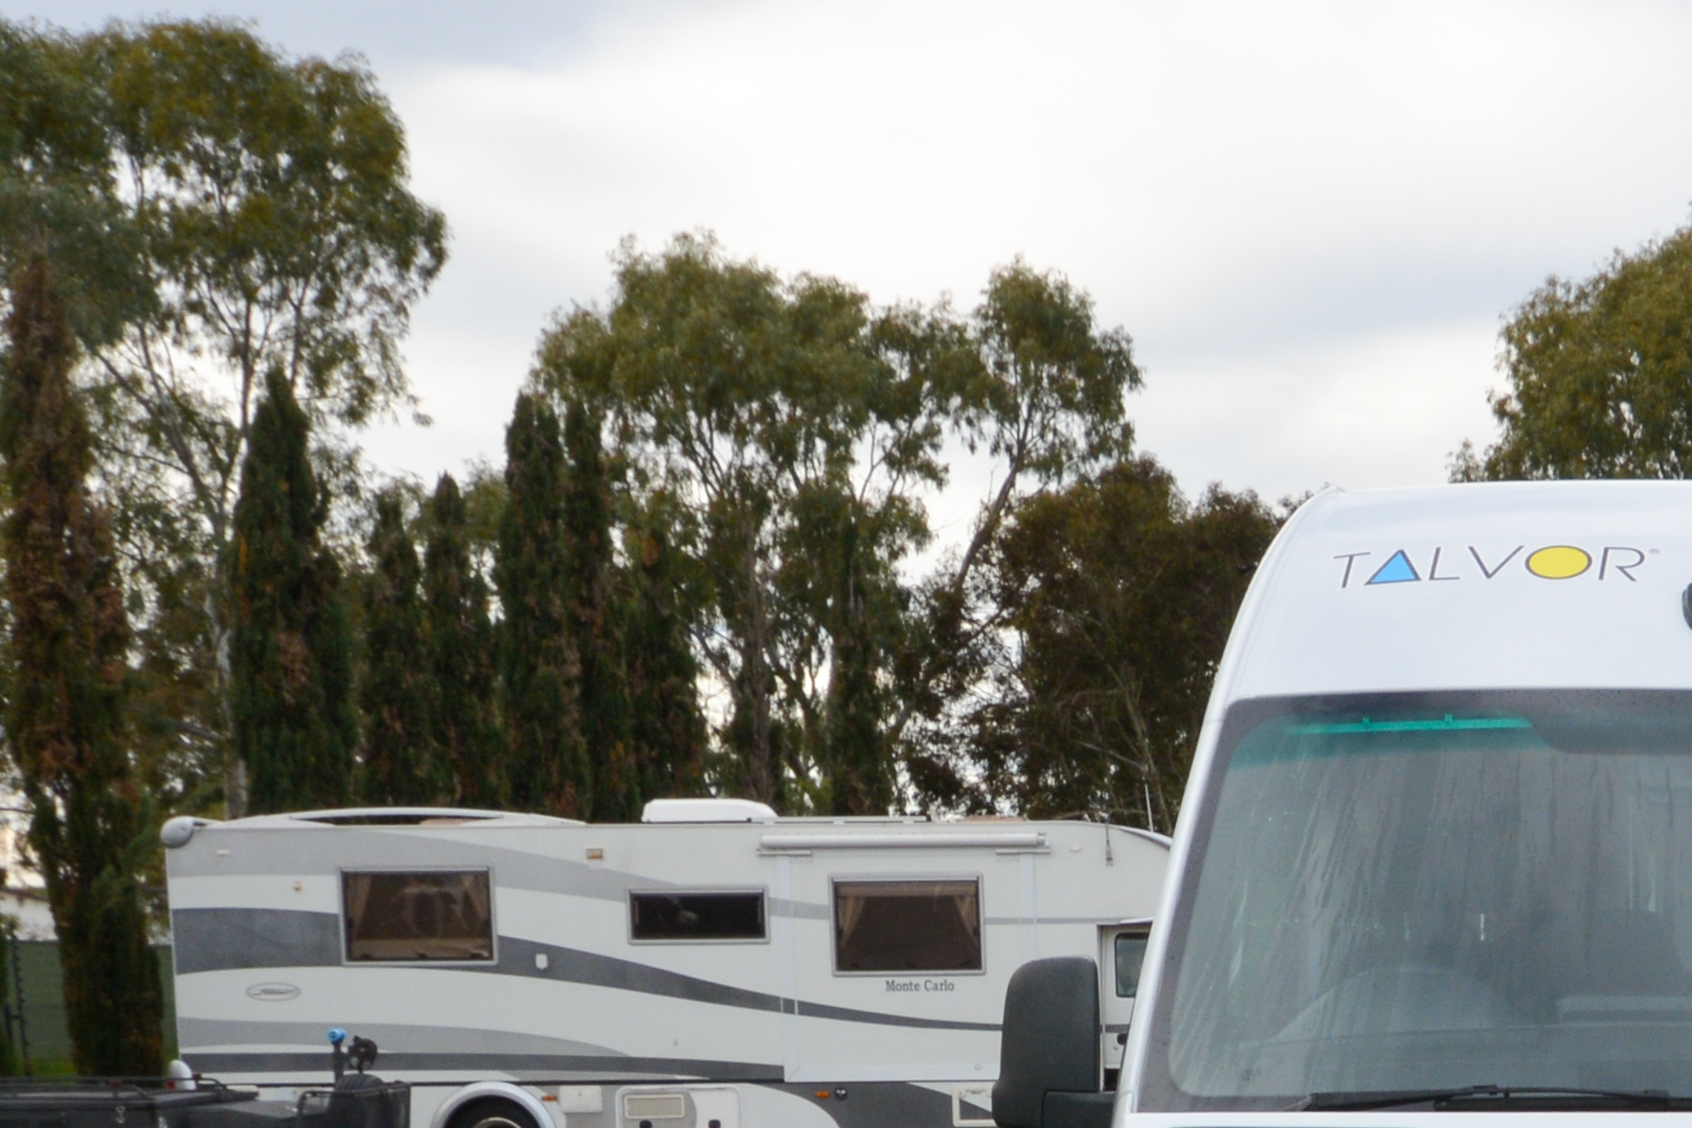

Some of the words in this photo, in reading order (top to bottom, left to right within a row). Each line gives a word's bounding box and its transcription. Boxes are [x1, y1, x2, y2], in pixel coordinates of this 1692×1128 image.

[1333, 544, 1646, 589] TALVOR
[885, 980, 921, 992] Monte
[924, 979, 955, 992] Carlo
